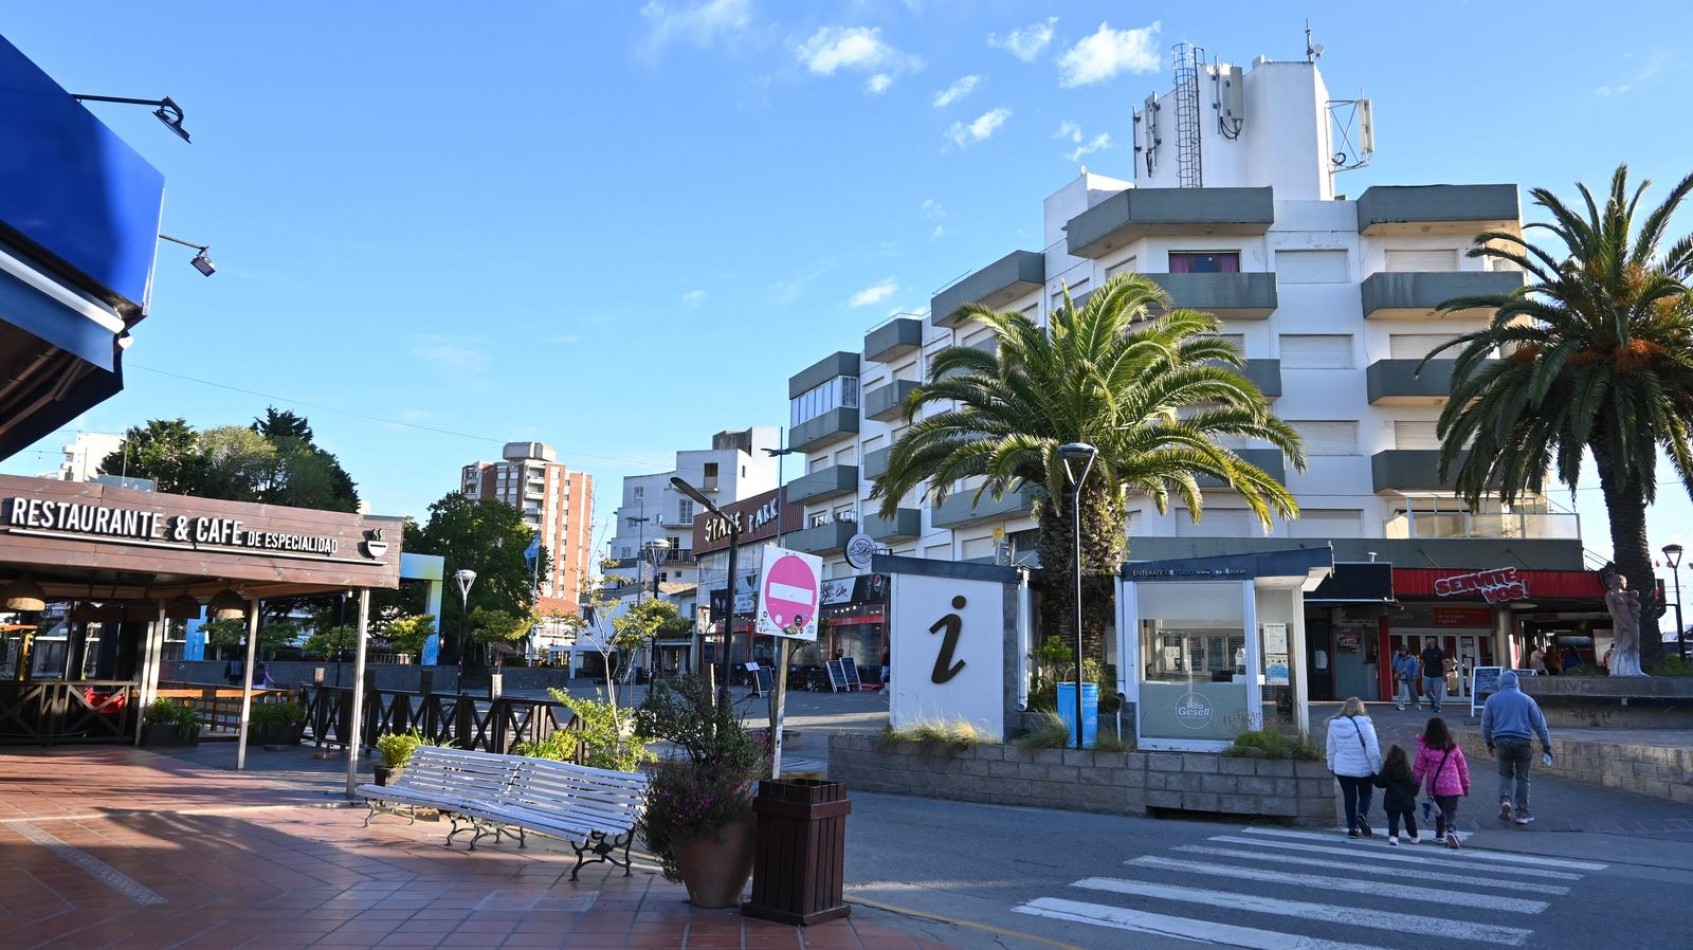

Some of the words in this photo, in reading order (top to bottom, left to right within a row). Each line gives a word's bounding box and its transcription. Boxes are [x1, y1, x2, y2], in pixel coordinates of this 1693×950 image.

[11, 497, 164, 538] RESTAURANTE
[174, 515, 190, 541] &
[196, 517, 243, 545] CAFE
[247, 531, 262, 547] DE
[265, 532, 338, 553] ESPECIALIDAD
[748, 497, 779, 534] PARK
[1435, 566, 1517, 596] SERVITE
[1480, 579, 1529, 604] VOS!
[1178, 707, 1210, 716] Gesell
[1186, 702, 1204, 710] Villa
